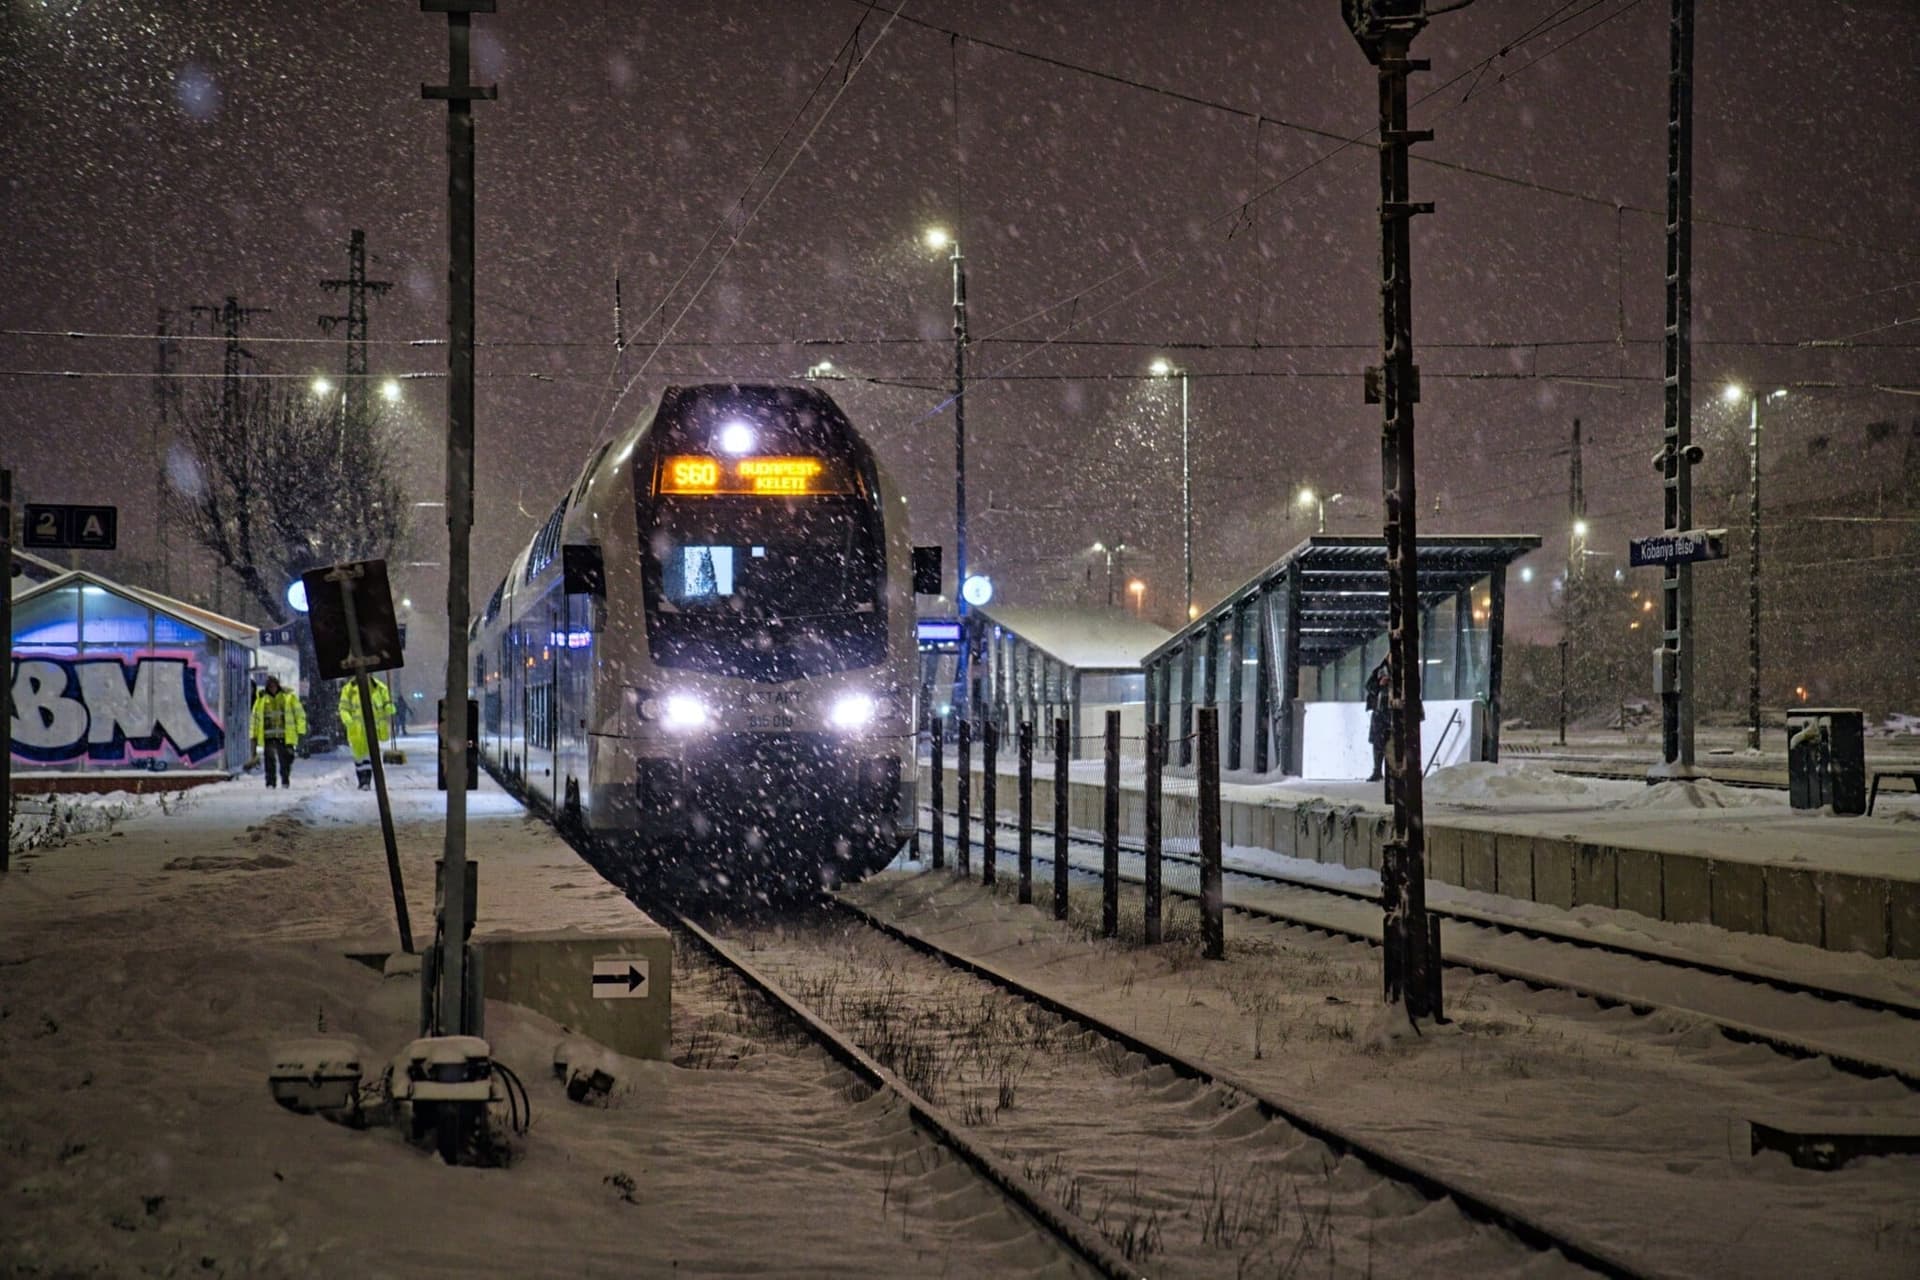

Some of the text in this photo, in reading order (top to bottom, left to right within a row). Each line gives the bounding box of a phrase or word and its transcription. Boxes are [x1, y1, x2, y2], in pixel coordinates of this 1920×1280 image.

[674, 462, 717, 485] S60
[756, 477, 806, 489] KELETI
[36, 512, 103, 537] 2 A
[264, 632, 272, 642] 2
